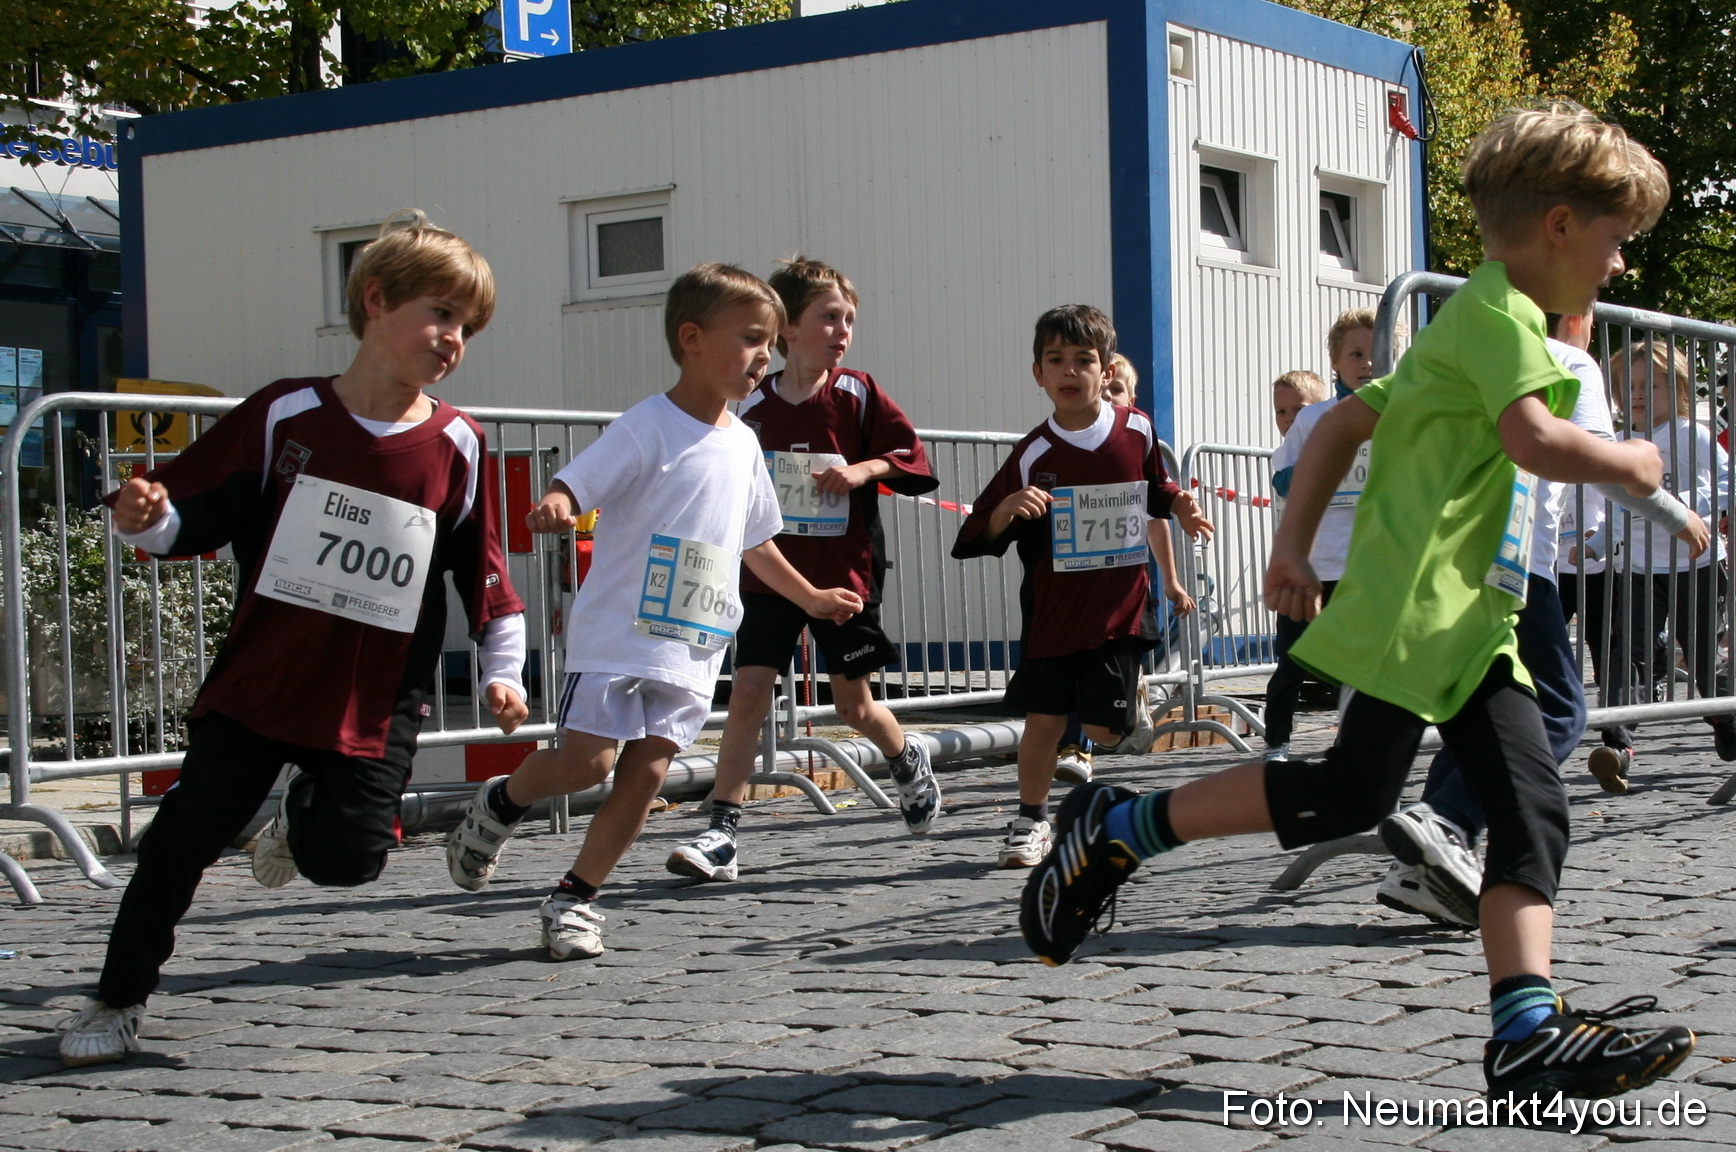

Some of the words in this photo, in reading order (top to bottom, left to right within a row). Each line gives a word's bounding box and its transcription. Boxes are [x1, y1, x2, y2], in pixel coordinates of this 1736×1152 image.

[519, 0, 553, 42] P
[778, 457, 811, 475] David
[323, 491, 372, 526] Elias
[1079, 491, 1142, 510] Maximilian
[1056, 519, 1069, 532] K2
[1081, 515, 1140, 542] 7153
[316, 531, 415, 588] 7000
[684, 547, 714, 572] Finn
[649, 571, 667, 589] K2
[348, 596, 400, 618] PFLEIDERER
